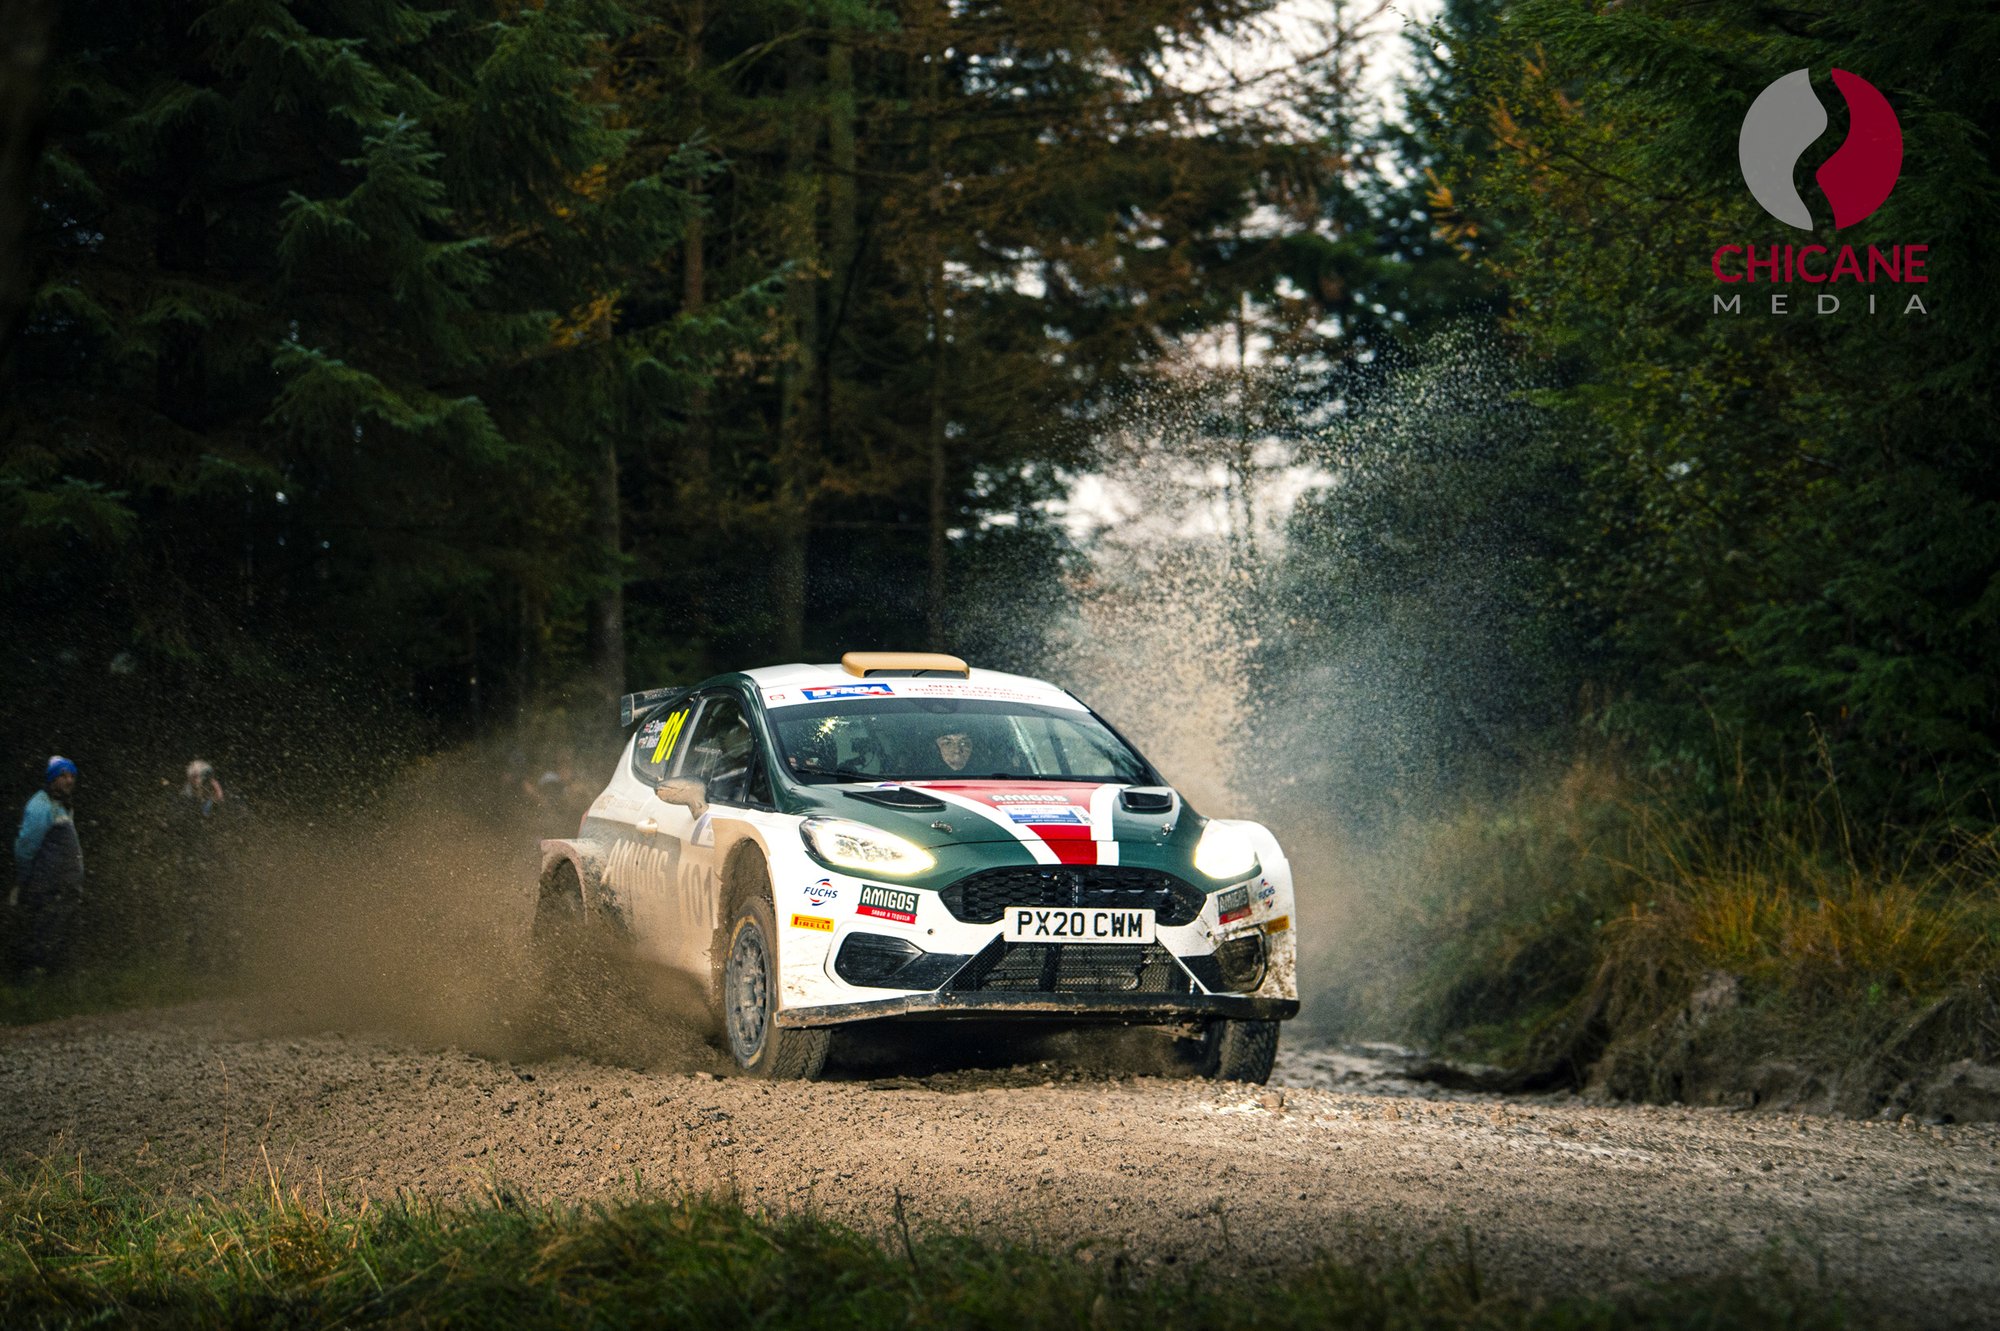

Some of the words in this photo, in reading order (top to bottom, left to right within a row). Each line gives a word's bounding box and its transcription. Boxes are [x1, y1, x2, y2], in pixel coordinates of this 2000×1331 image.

[651, 708, 690, 764] 101
[600, 838, 669, 894] AMIGOS
[803, 886, 839, 899] FUCHS
[861, 887, 916, 912] AMIGOS
[794, 916, 831, 930] PIRELLI
[1017, 911, 1085, 937] PX20
[1094, 912, 1143, 938] CWM
